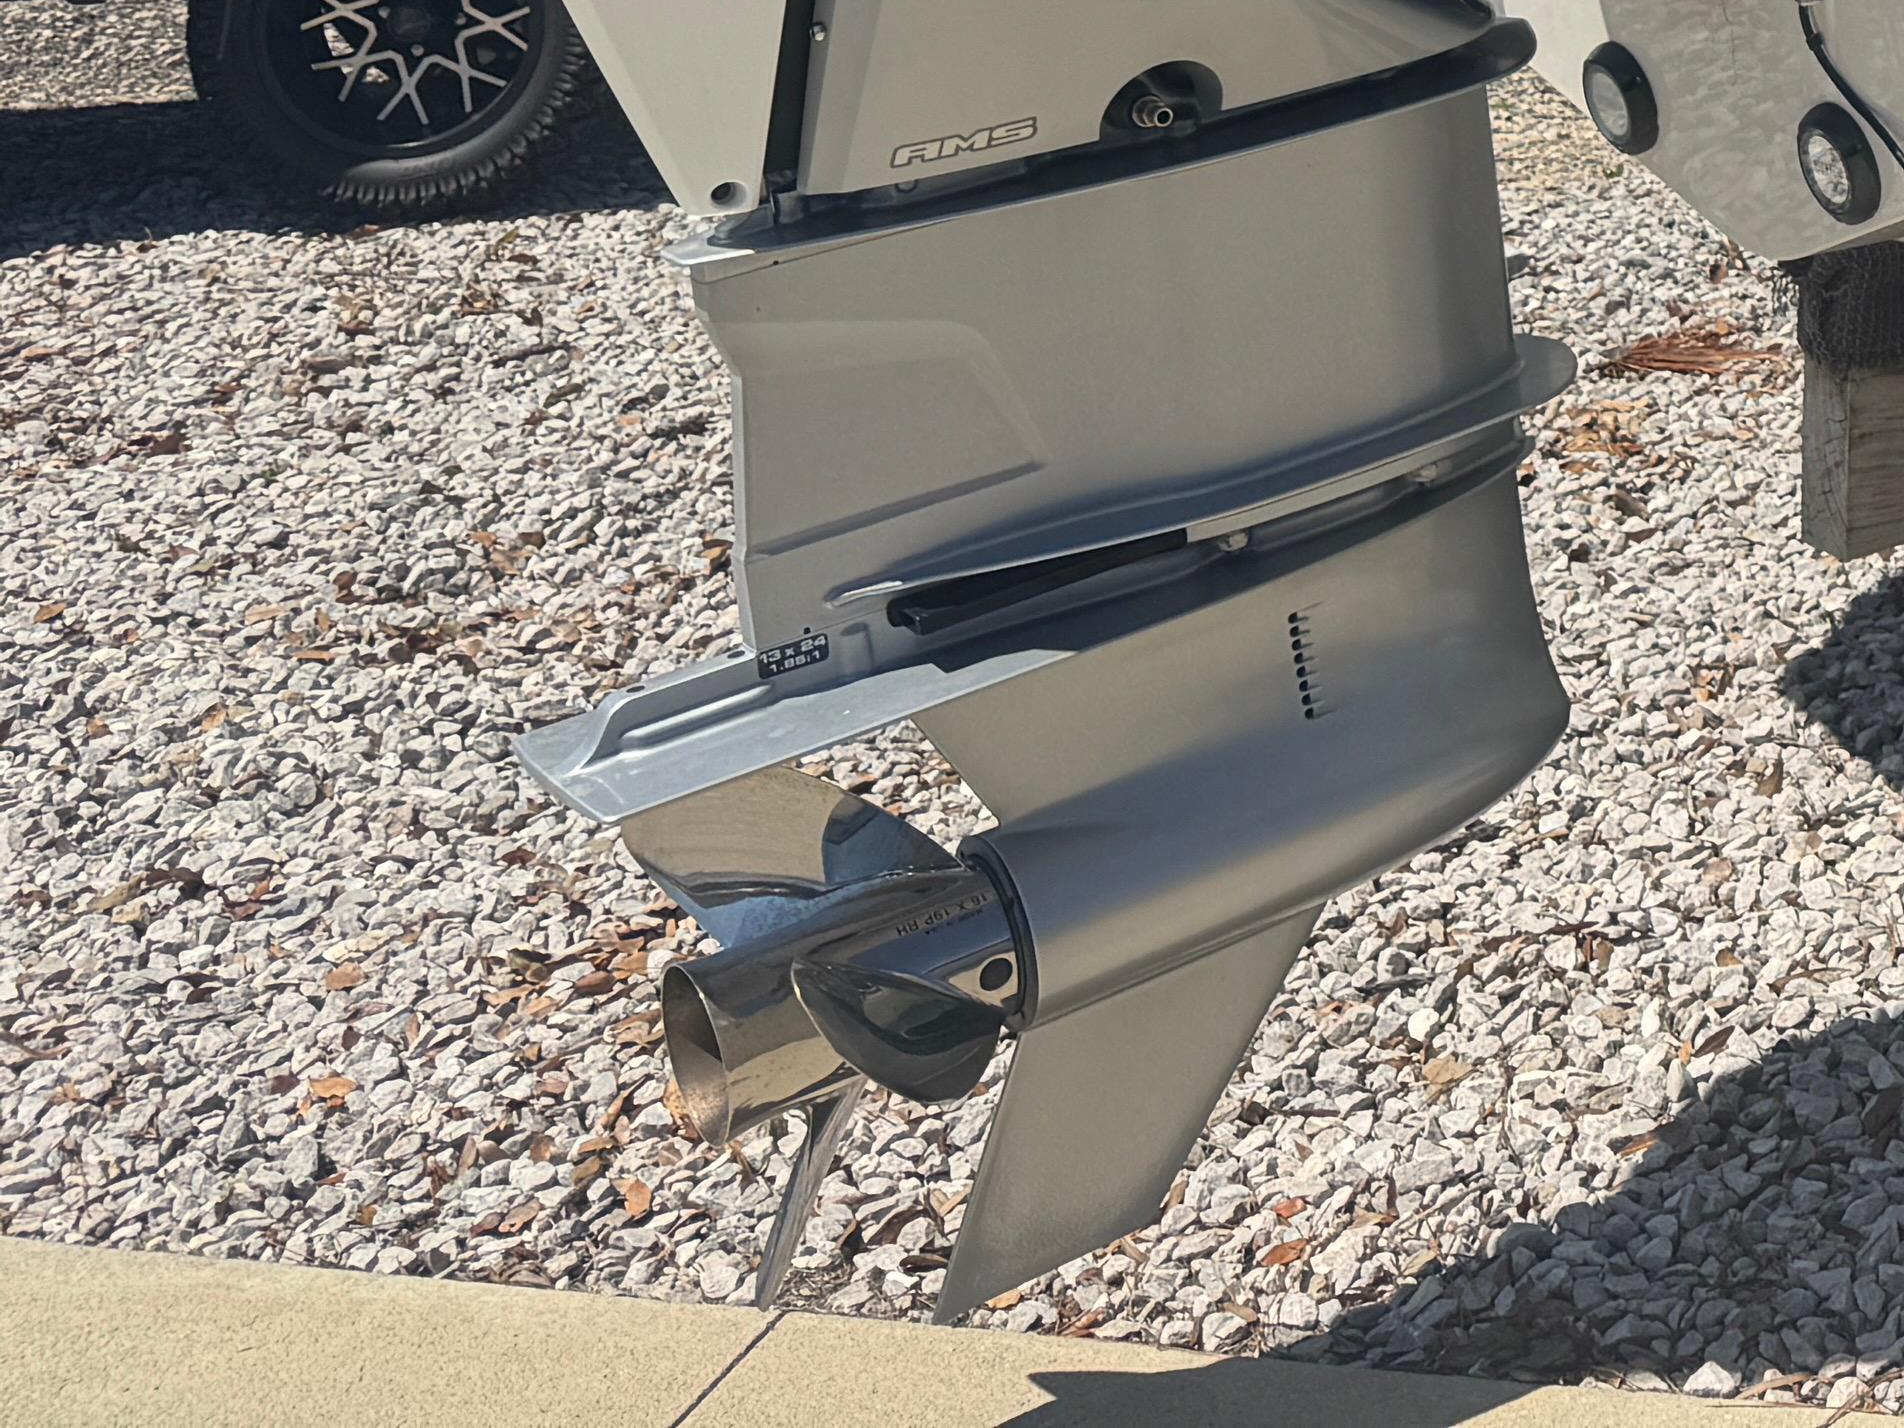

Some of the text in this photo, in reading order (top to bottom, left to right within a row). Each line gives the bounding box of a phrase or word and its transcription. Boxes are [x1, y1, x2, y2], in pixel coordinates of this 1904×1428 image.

[890, 117, 1038, 169] AMS
[760, 649, 781, 663] 13
[801, 635, 826, 652] 24
